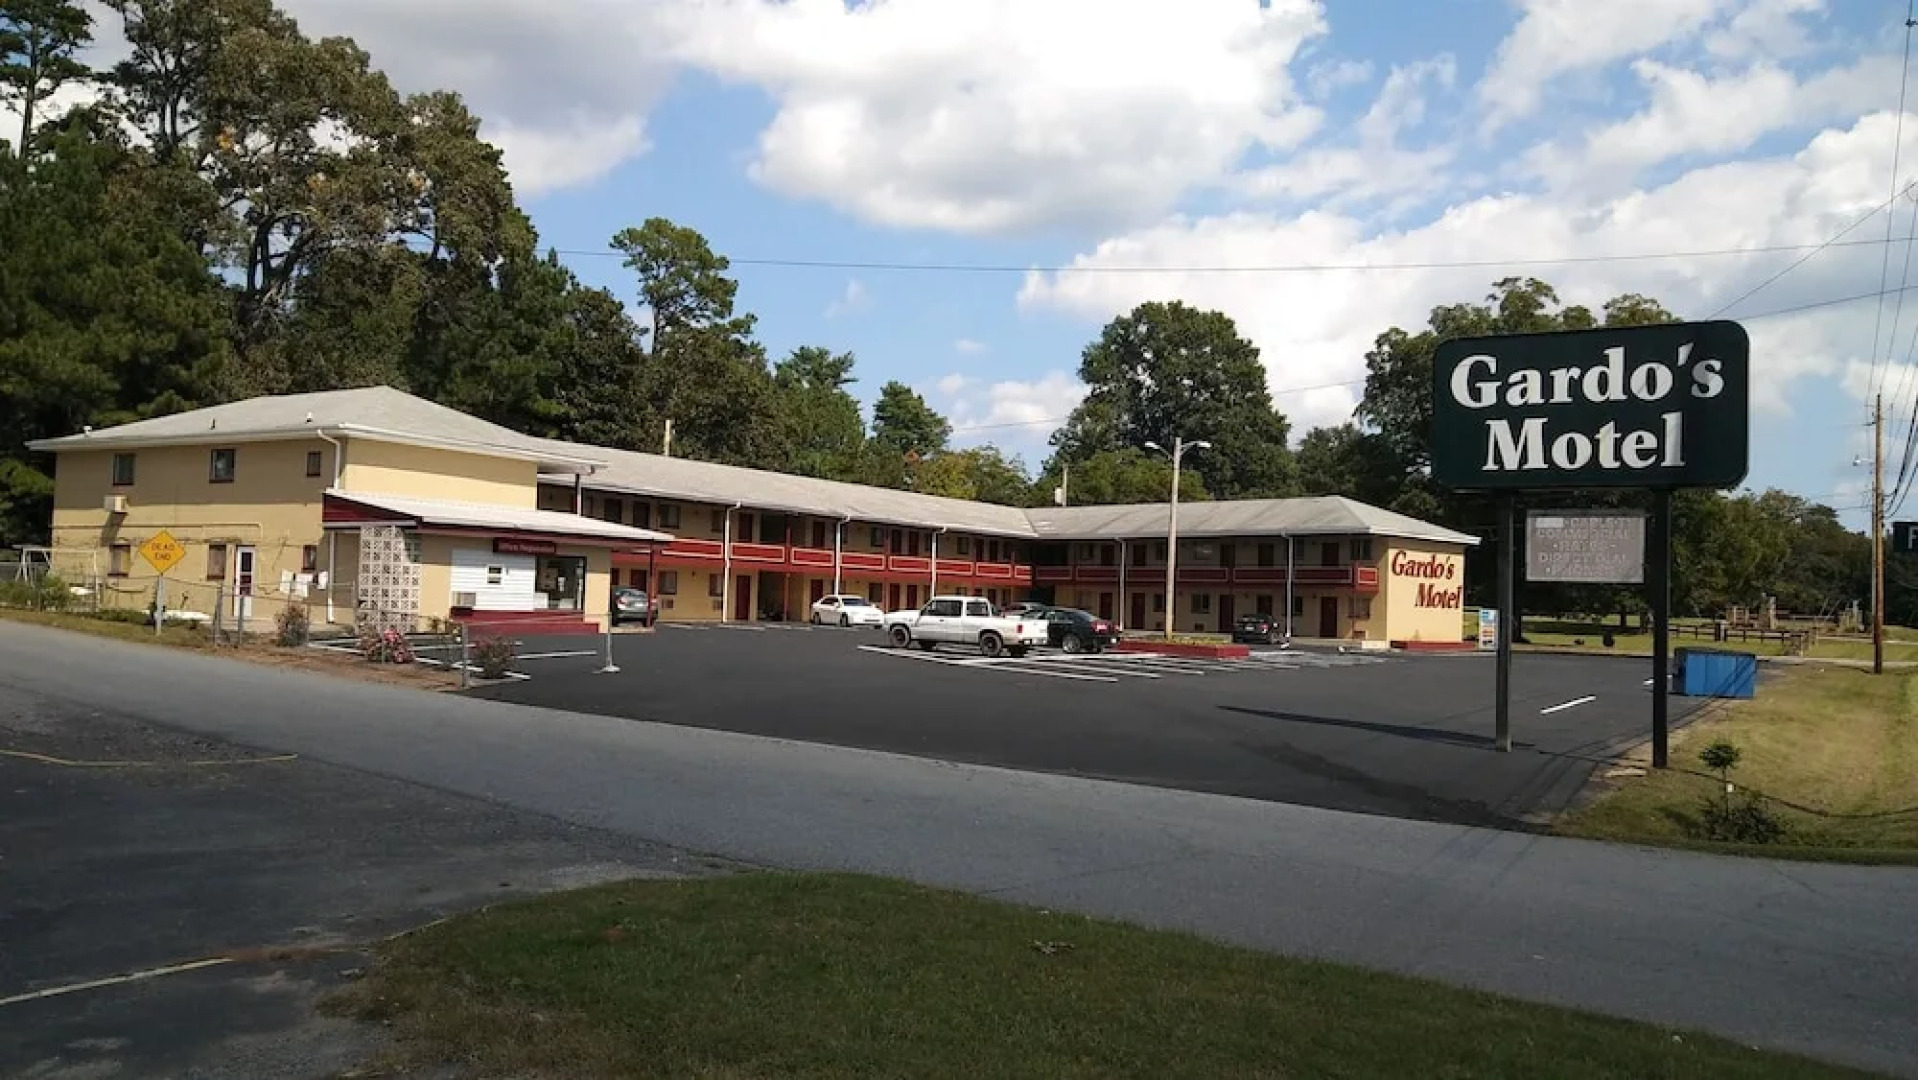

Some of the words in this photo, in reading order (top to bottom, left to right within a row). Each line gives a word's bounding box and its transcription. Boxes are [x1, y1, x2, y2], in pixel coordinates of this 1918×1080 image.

[1451, 342, 1725, 409] Gardo's
[1482, 411, 1686, 471] Motel
[151, 542, 175, 551] DEAD
[155, 552, 171, 561] END
[1392, 550, 1455, 580] Gardo's
[1414, 583, 1462, 609] Motel
